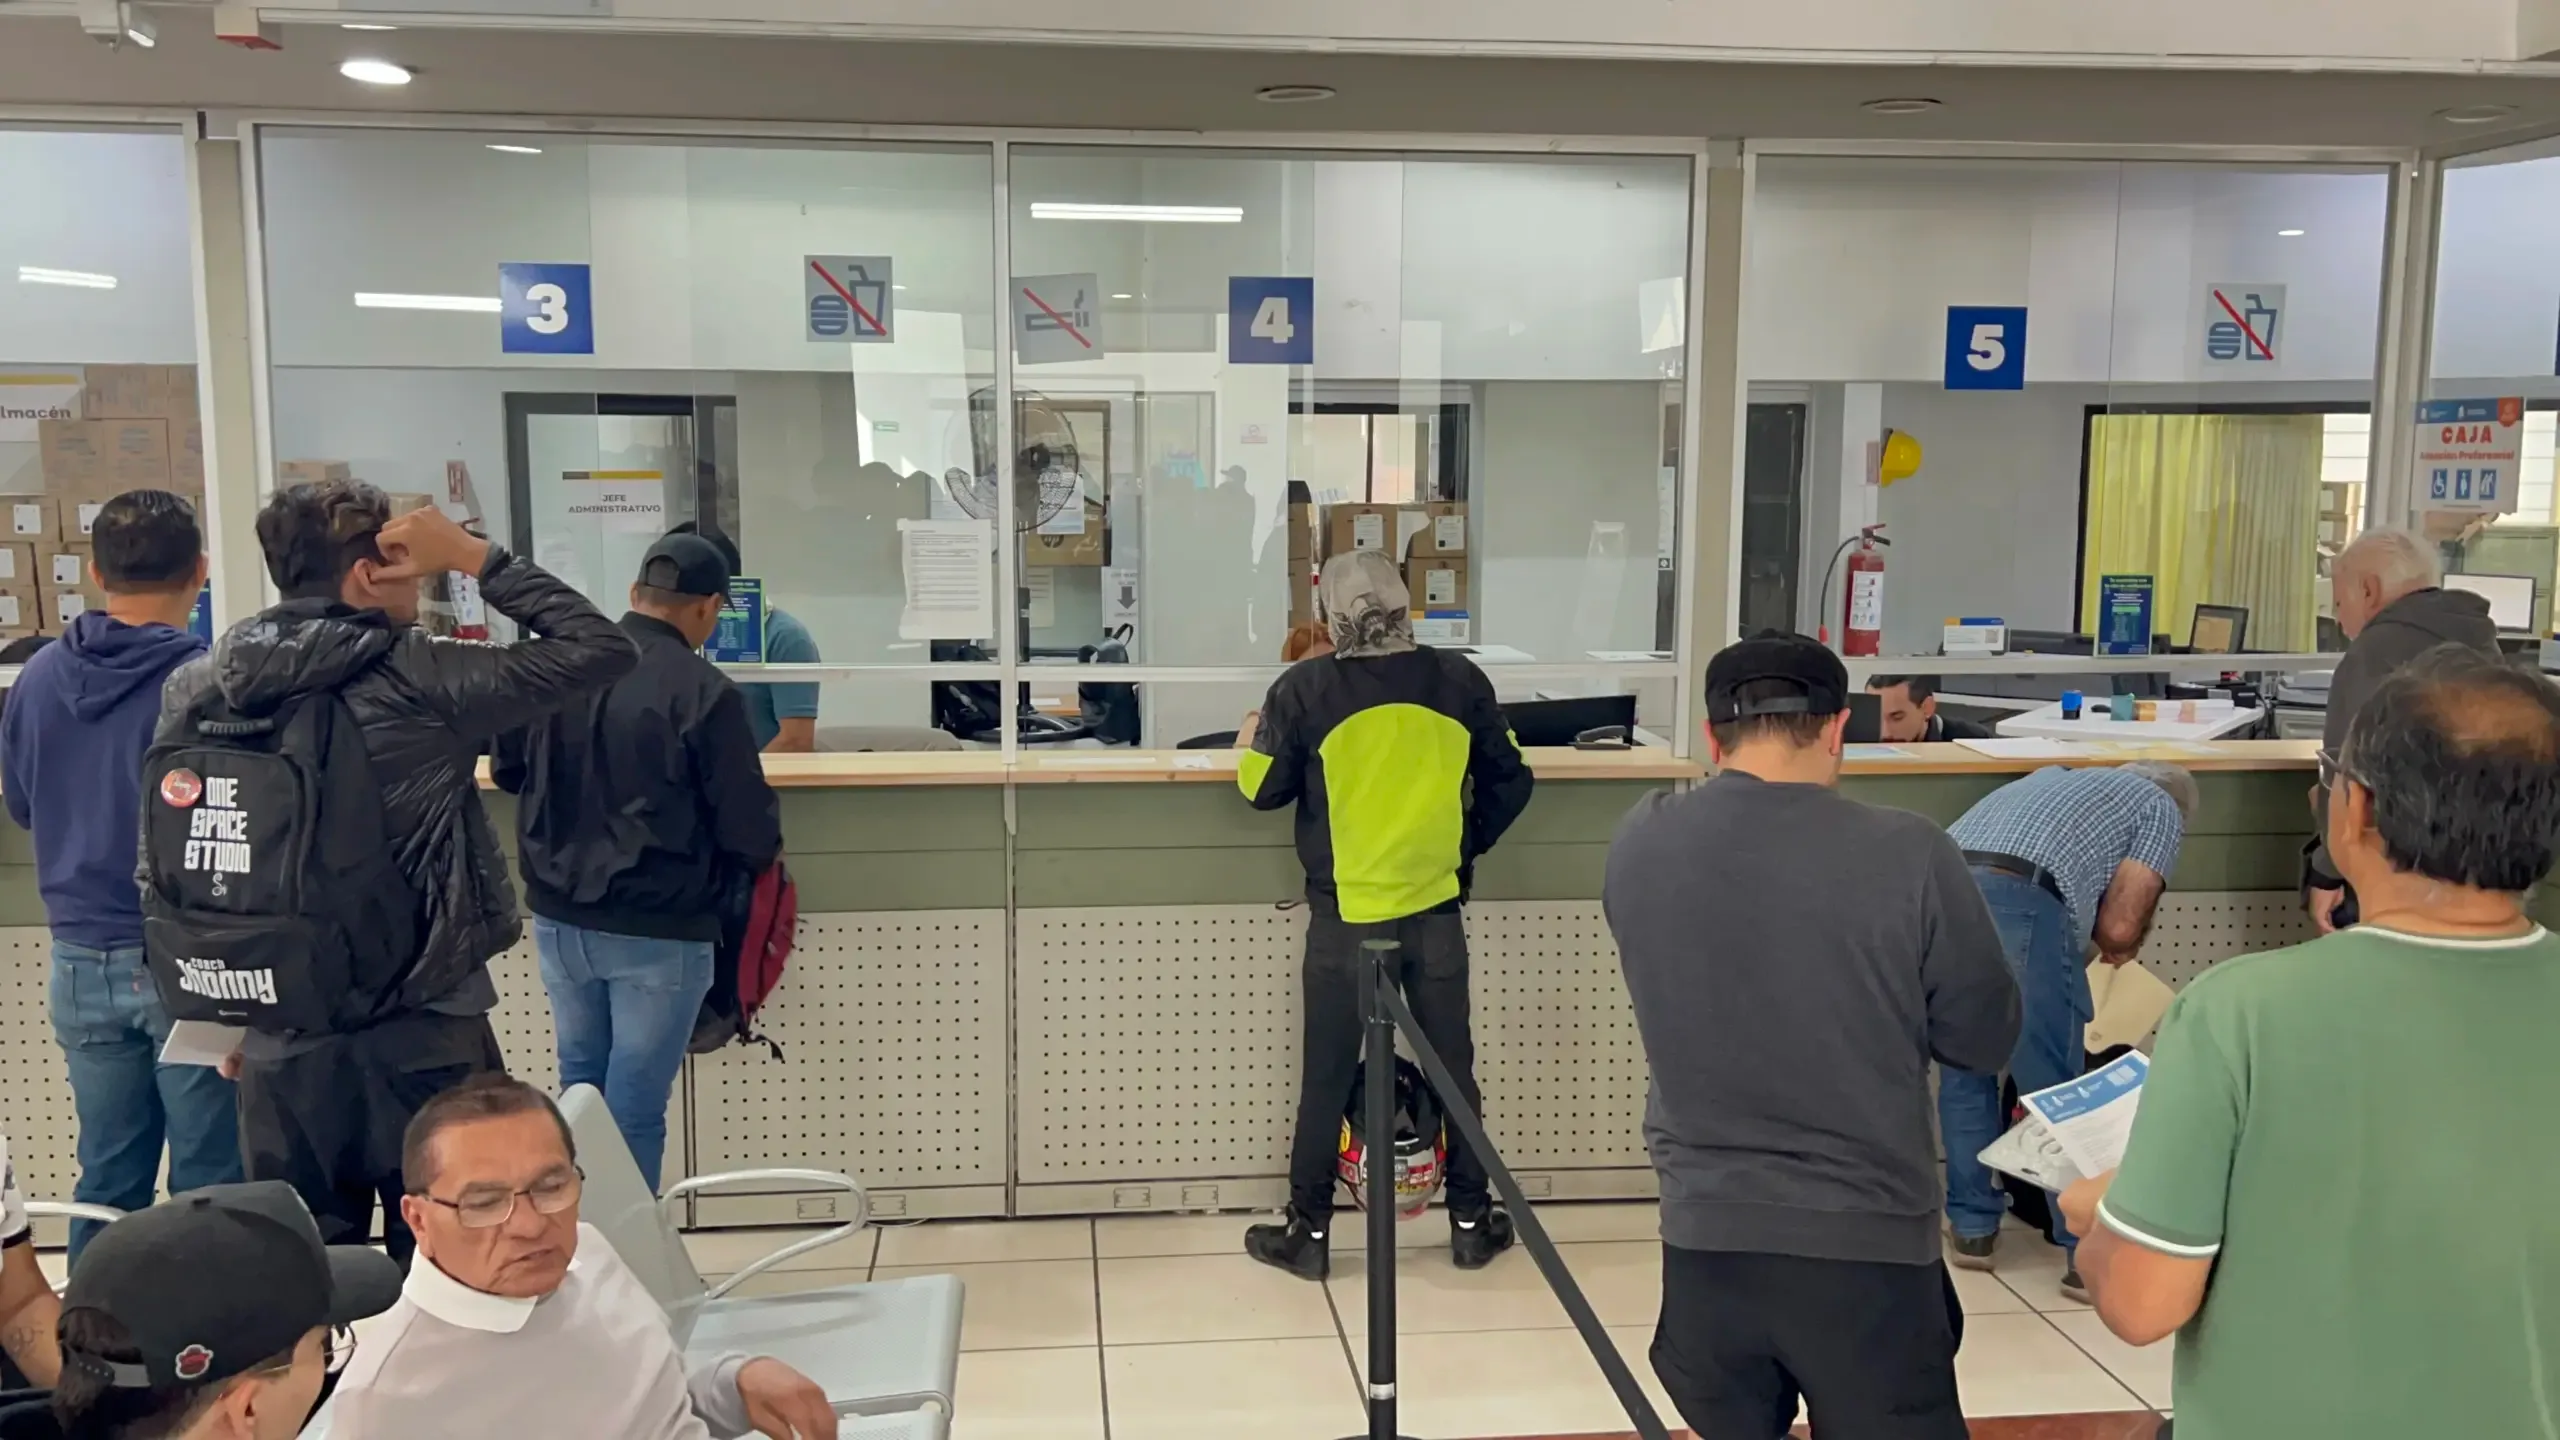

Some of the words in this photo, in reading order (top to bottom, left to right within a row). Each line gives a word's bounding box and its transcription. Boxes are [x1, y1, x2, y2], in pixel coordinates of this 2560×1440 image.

[526, 283, 569, 334] 3
[1250, 297, 1294, 344] 4
[1966, 324, 2006, 371] 5
[2441, 425, 2492, 444] CAJA
[568, 504, 662, 513] ADMINISTRATIVO
[602, 494, 627, 502] JEFE
[206, 777, 238, 807] ONE
[190, 808, 248, 840] SPACE
[184, 839, 251, 873] STUDIO
